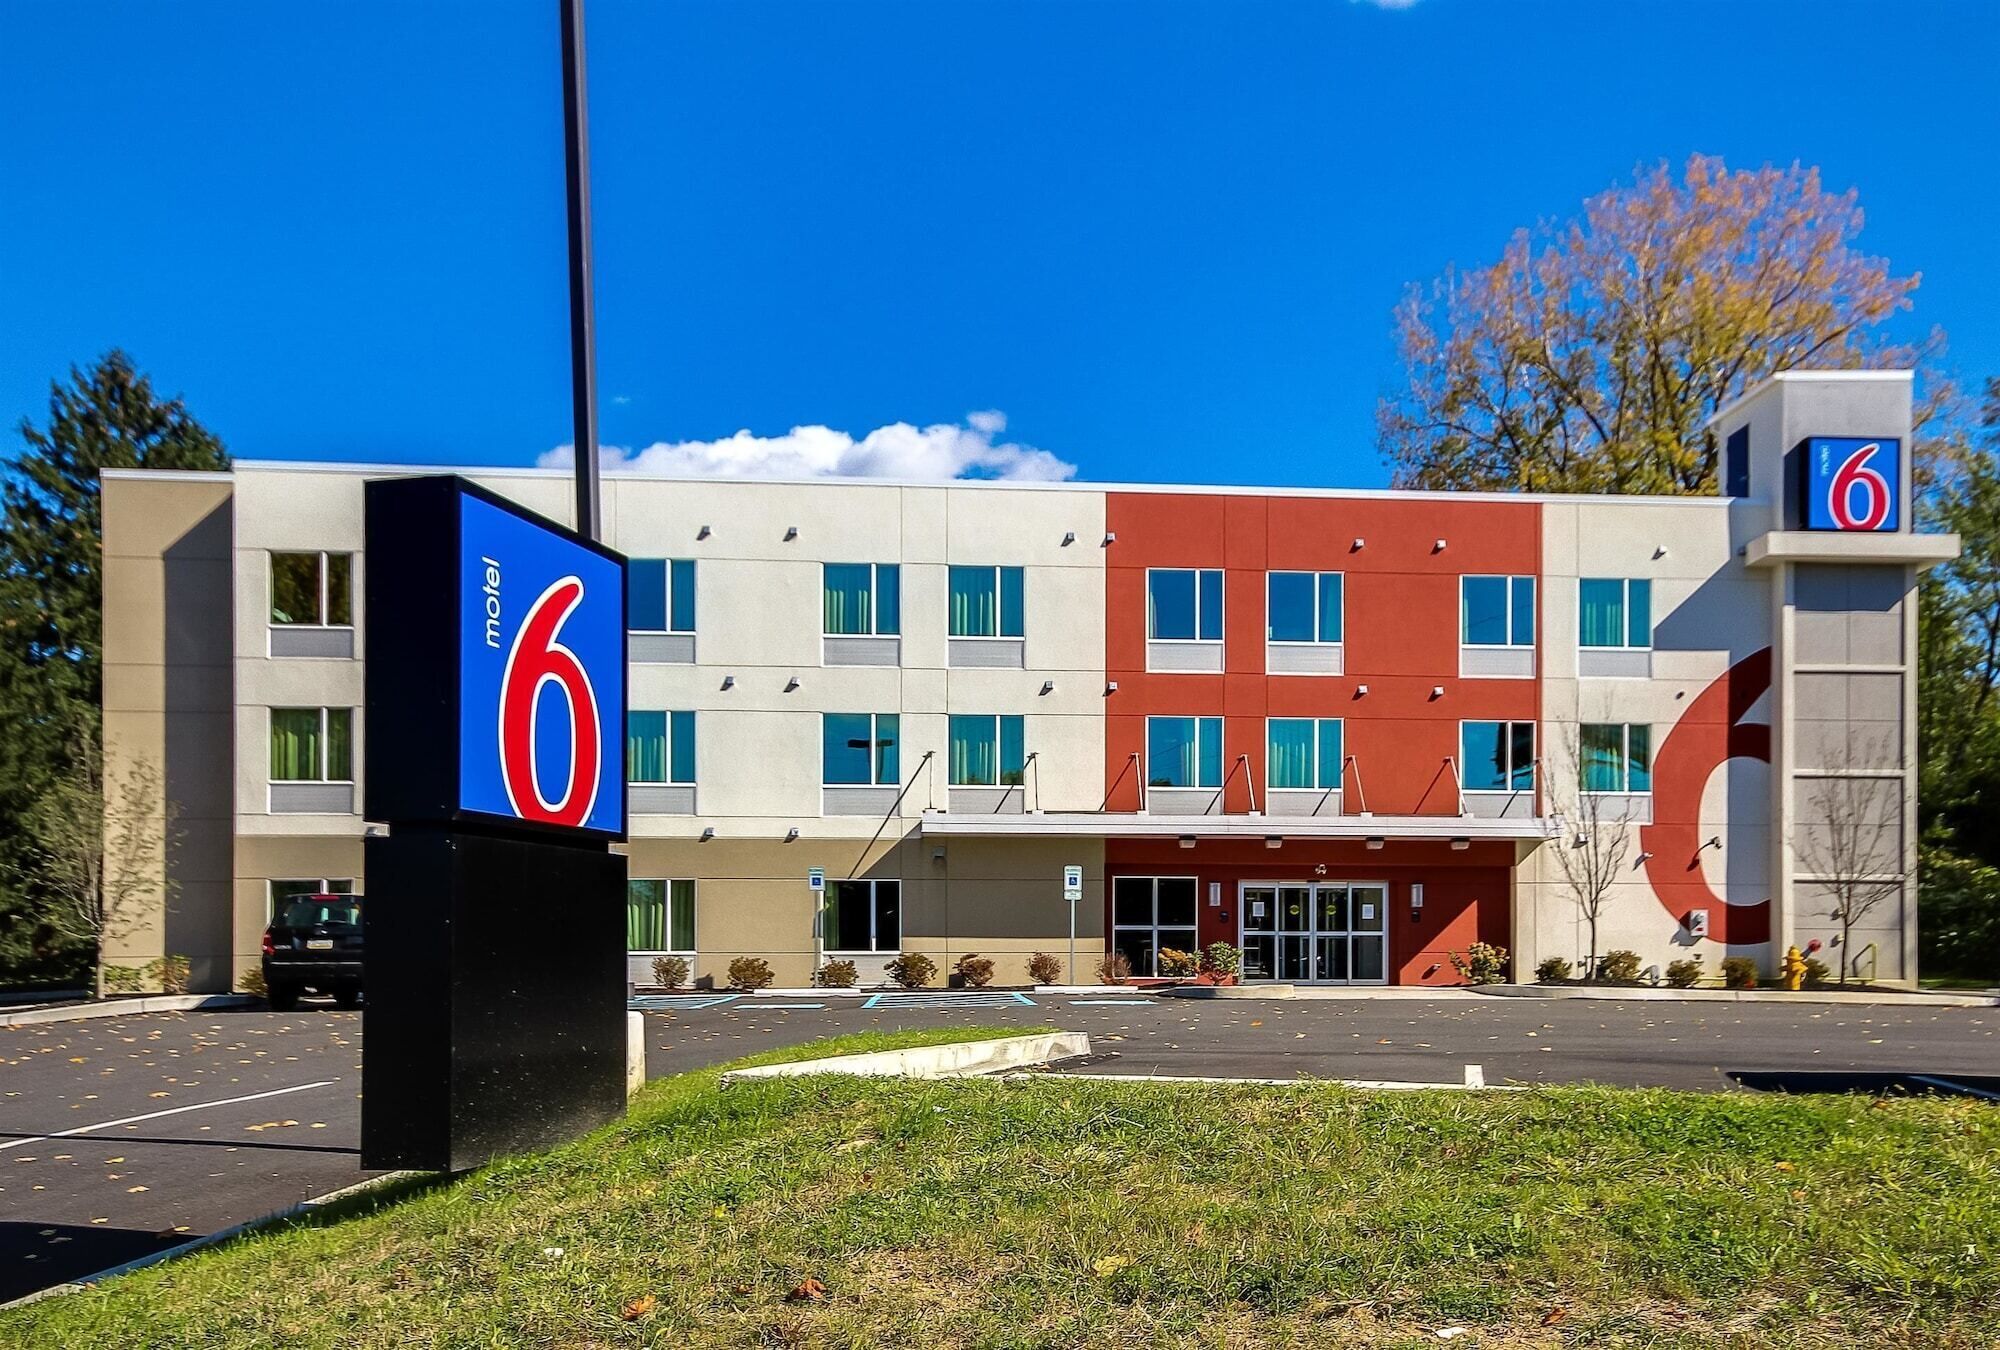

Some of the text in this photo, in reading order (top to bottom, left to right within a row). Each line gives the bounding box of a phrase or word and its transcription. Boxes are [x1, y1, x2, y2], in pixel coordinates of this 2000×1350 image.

[1828, 443, 1890, 530] 6
[482, 556, 602, 827] motel 6
